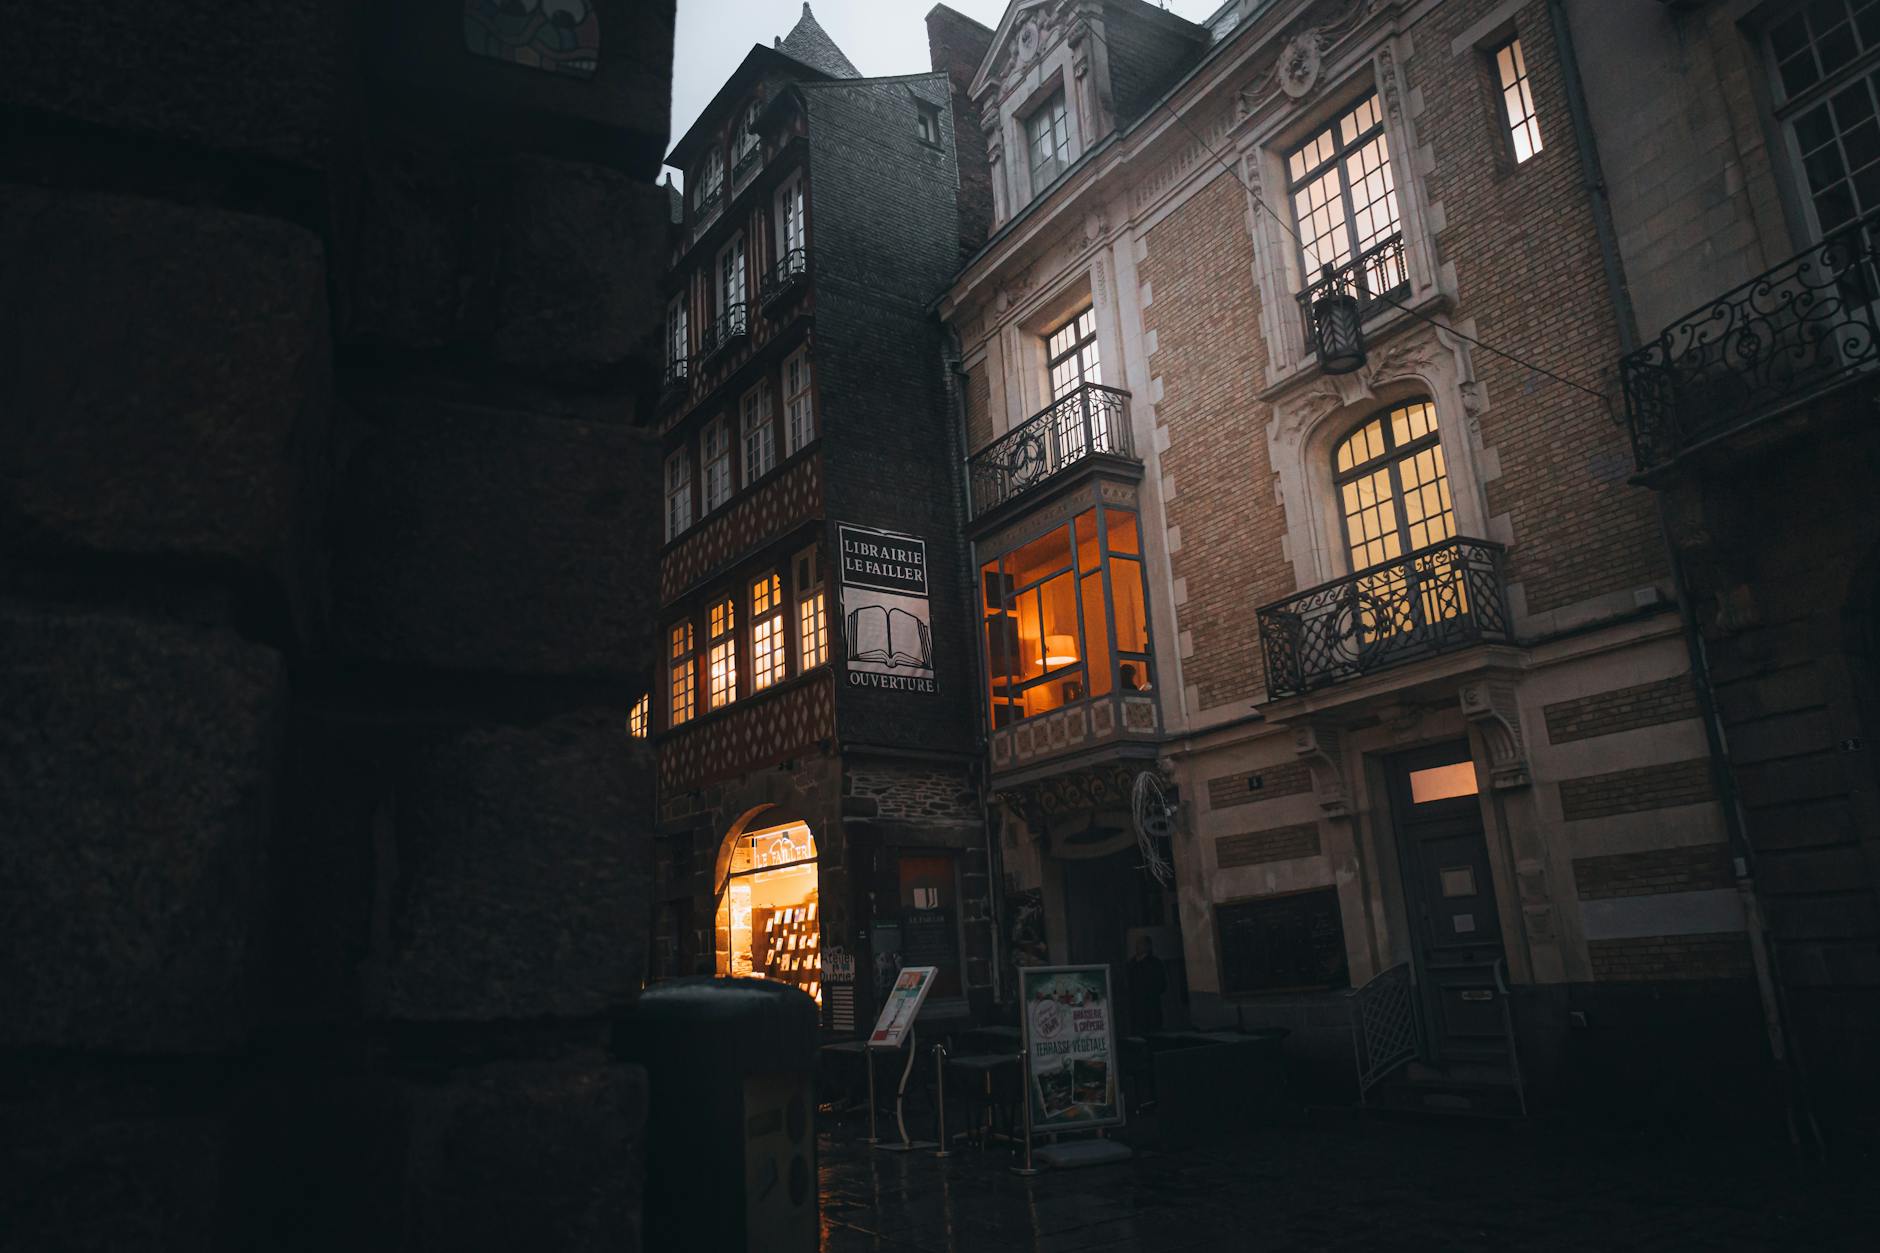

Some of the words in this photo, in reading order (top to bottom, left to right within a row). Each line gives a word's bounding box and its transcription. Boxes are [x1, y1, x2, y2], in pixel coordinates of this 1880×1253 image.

[845, 540, 922, 565] LIBRAIRIE
[845, 557, 863, 572] LE
[865, 561, 924, 582] FAILLER
[850, 672, 934, 693] OUVERTURE
[756, 852, 768, 868] LE
[770, 845, 807, 865] FAILLER
[1037, 1040, 1069, 1056] TERRASSE
